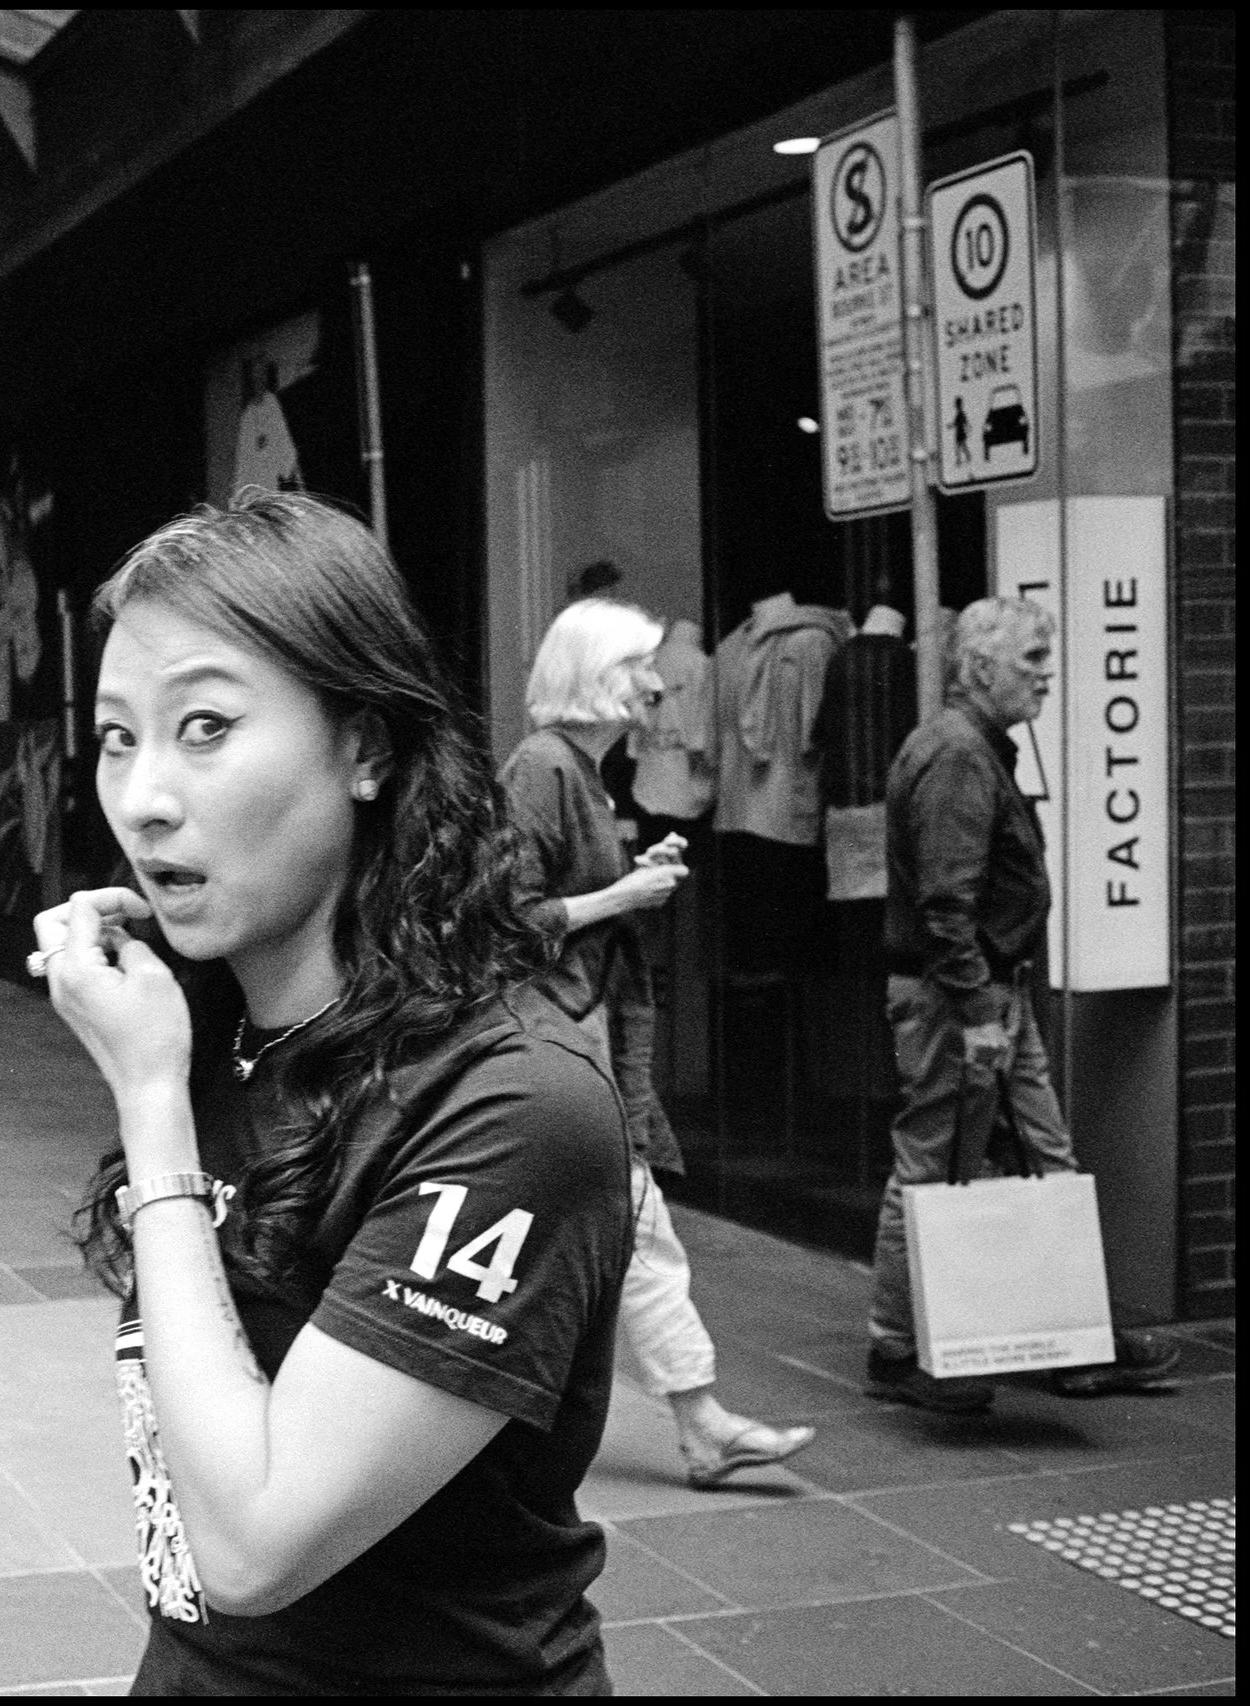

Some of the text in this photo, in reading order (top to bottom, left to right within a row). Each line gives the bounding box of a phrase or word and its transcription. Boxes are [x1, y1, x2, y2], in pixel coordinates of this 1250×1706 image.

[965, 223, 995, 271] 10
[834, 252, 891, 292] AREA
[945, 302, 1024, 349] SHARED
[960, 344, 1010, 383] ZONE
[1104, 576, 1140, 908] FACTORIE
[409, 1181, 535, 1303] 14
[381, 1279, 508, 1345] X VAINQUEUR
